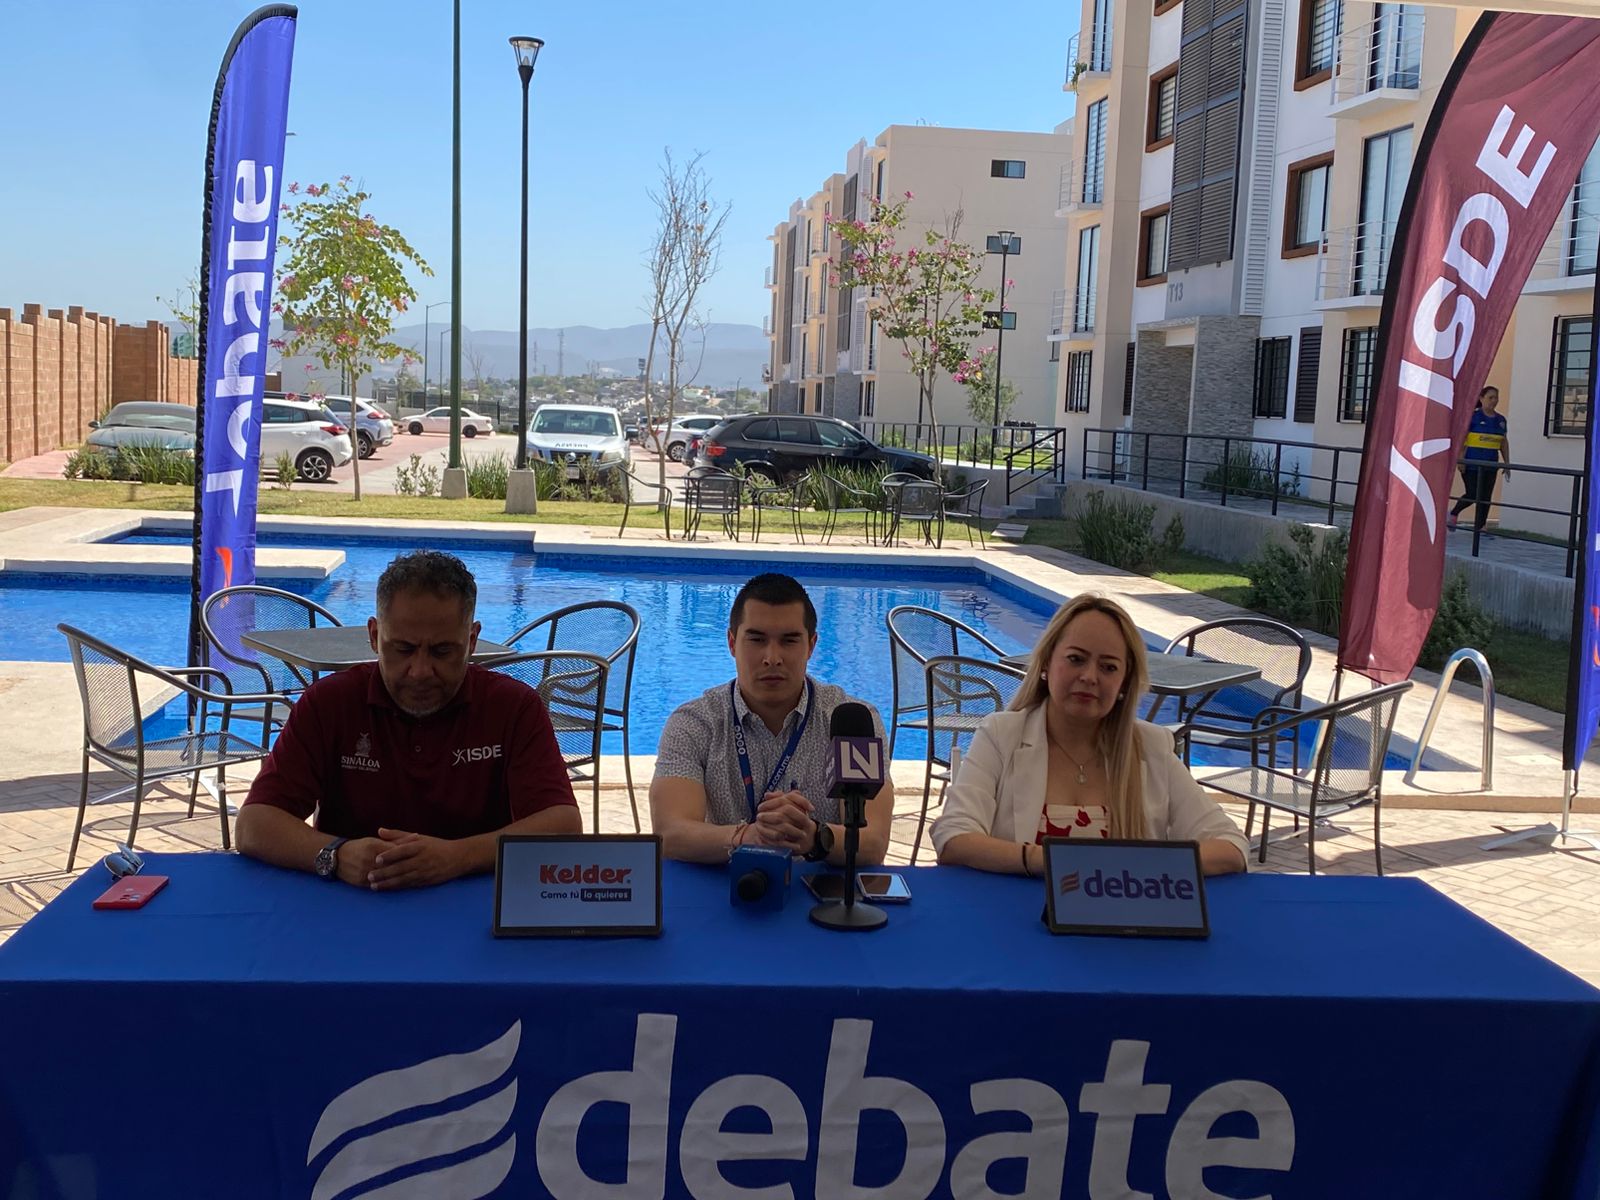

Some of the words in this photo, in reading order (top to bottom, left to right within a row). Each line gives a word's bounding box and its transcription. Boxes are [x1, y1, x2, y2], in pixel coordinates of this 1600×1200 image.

[1399, 104, 1557, 410] ISDE
[1168, 282, 1183, 302] T13
[341, 755, 381, 768] SINALOA
[467, 744, 502, 762] ISDE
[840, 741, 880, 780] LN
[540, 890, 568, 899] Como
[570, 889, 580, 899] tú
[584, 890, 592, 899] lo
[594, 891, 628, 901] quieres
[1084, 869, 1194, 900] debate
[536, 1013, 1296, 1200] debate
